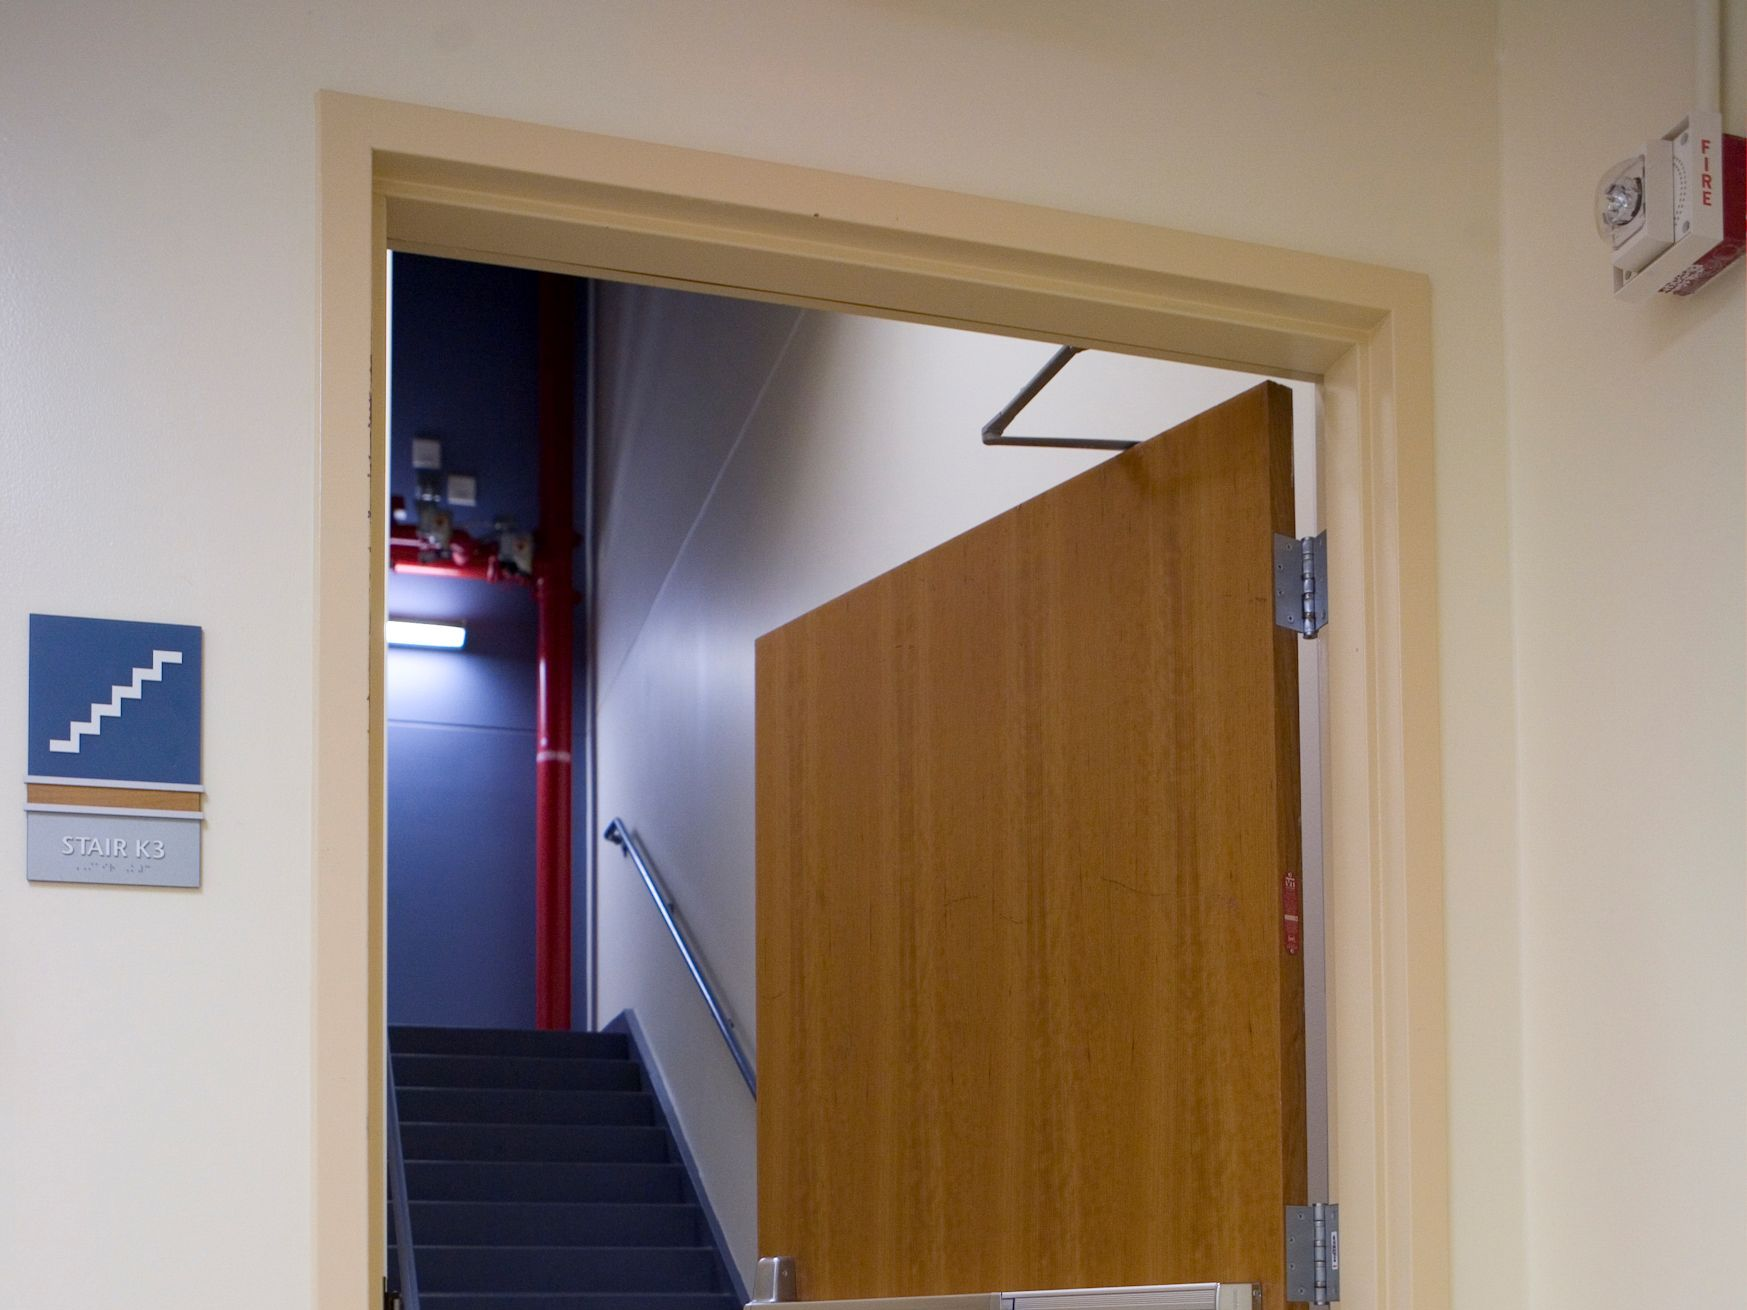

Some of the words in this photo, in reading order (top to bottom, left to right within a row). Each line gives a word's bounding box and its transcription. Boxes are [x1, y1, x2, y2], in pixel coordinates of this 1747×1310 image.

[1701, 139, 1712, 206] FIRE
[61, 836, 128, 858] STAIR
[136, 839, 166, 860] K3
